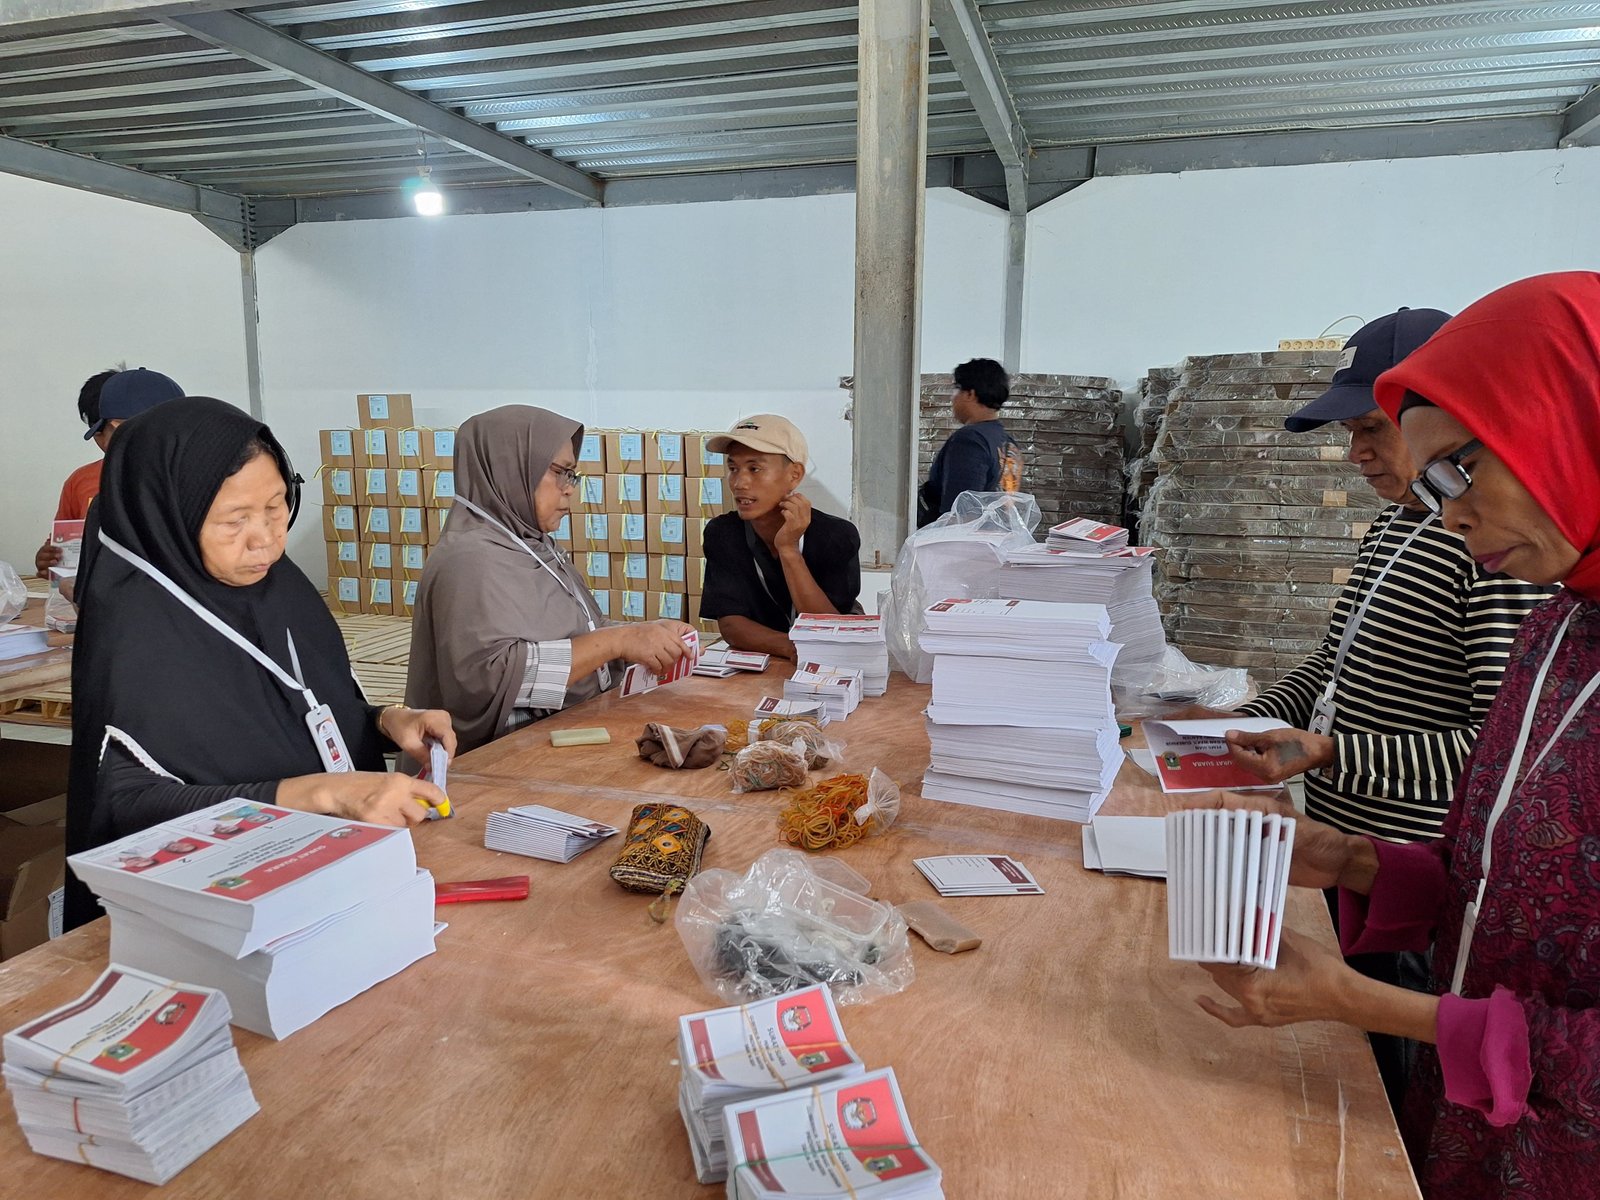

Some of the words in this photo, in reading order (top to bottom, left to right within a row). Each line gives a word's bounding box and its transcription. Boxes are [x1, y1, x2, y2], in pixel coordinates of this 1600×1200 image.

[298, 844, 327, 861] SURAT
[264, 856, 299, 873] SUARA
[767, 1027, 779, 1049] SURAT
